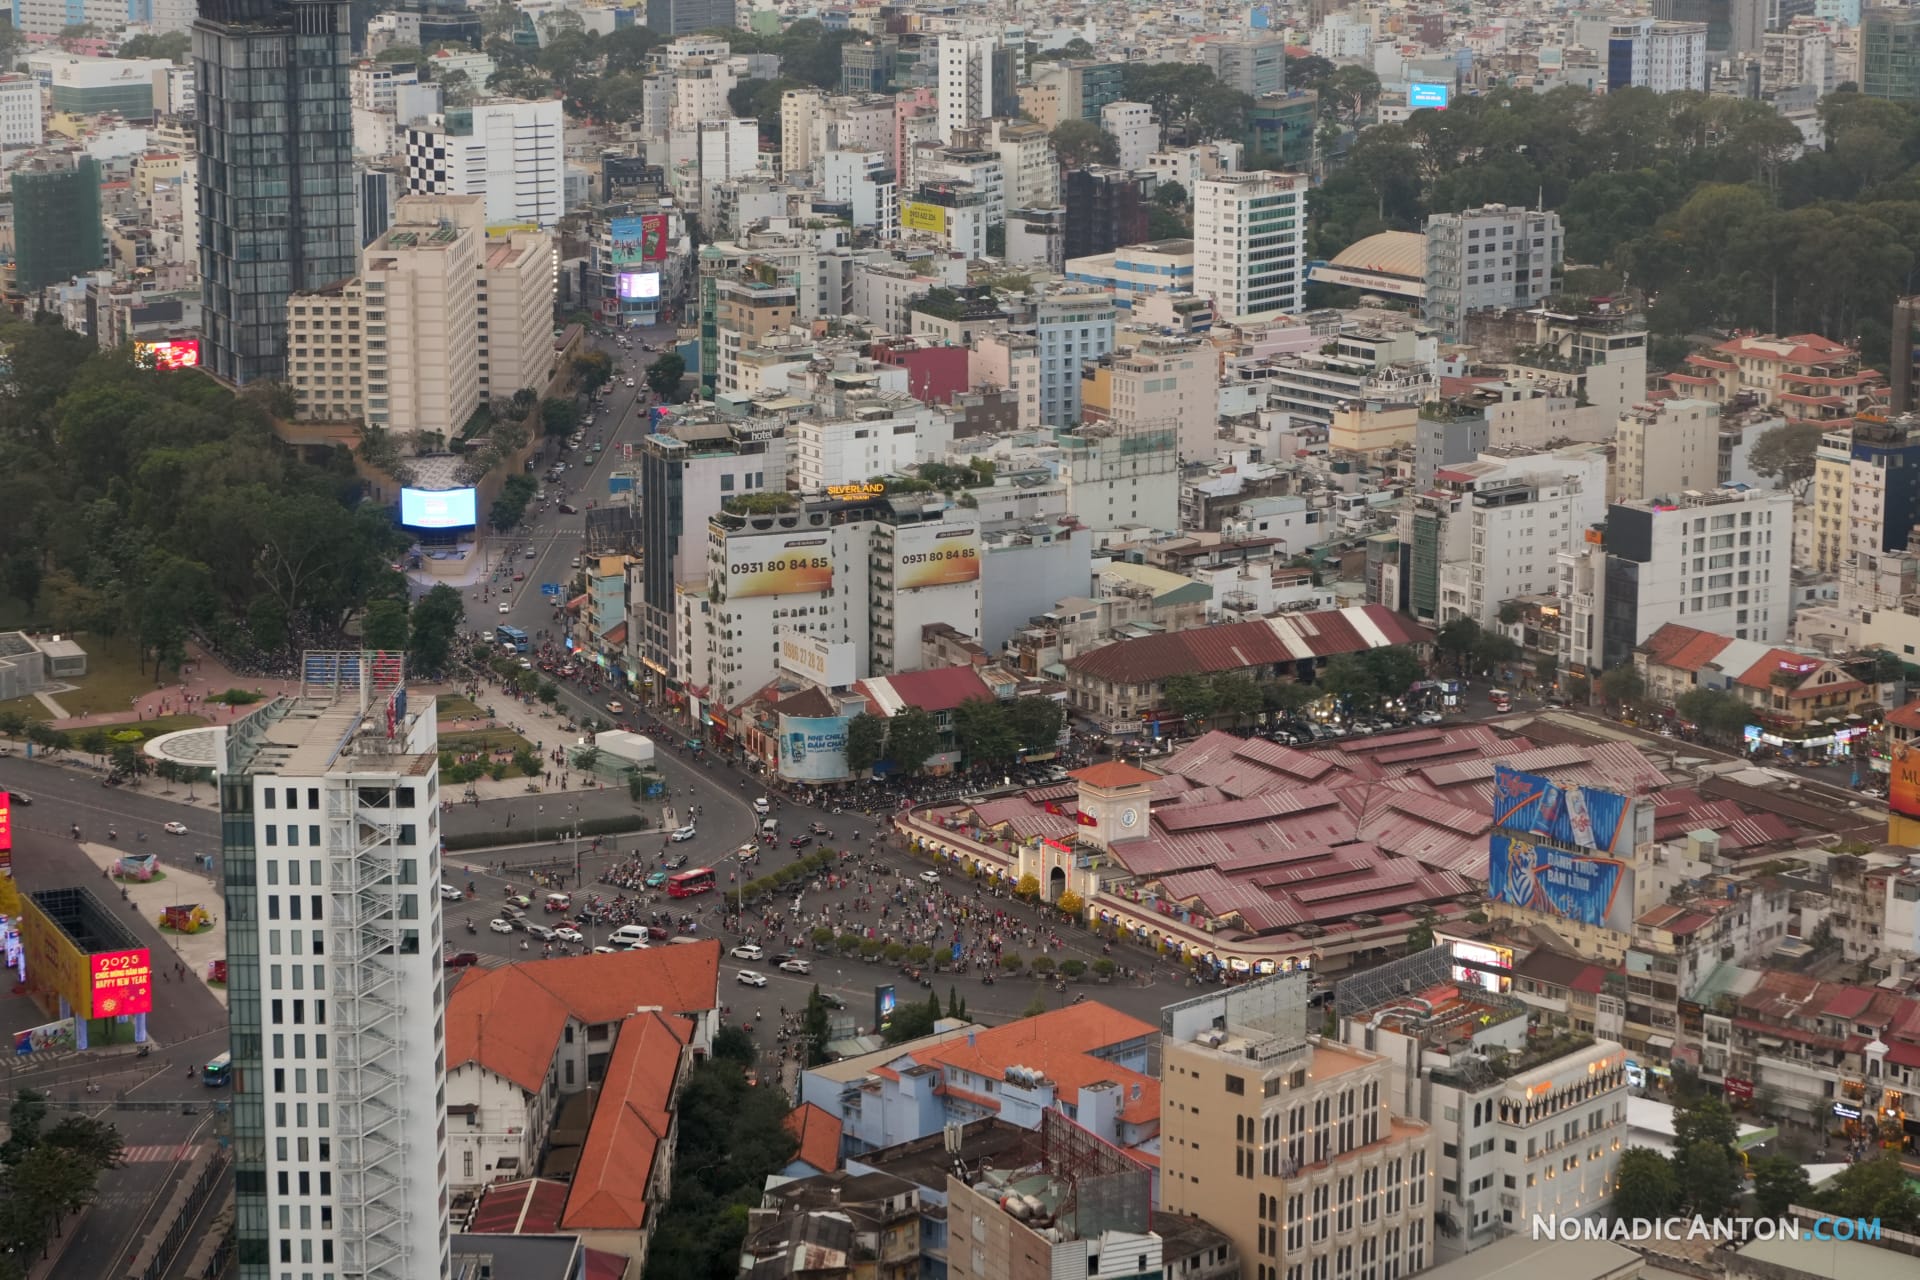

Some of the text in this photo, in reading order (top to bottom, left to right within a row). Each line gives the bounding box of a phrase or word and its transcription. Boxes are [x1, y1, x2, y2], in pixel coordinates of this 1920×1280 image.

[752, 430, 773, 440] hotel
[828, 484, 884, 494] SILVERLAND
[902, 548, 974, 564] 0931 80 84 85
[732, 557, 828, 574] 0931 80 84 85
[1500, 773, 1533, 797] Tiger
[100, 954, 139, 970] 2025
[96, 975, 147, 988] HAPPY NEW YEAR
